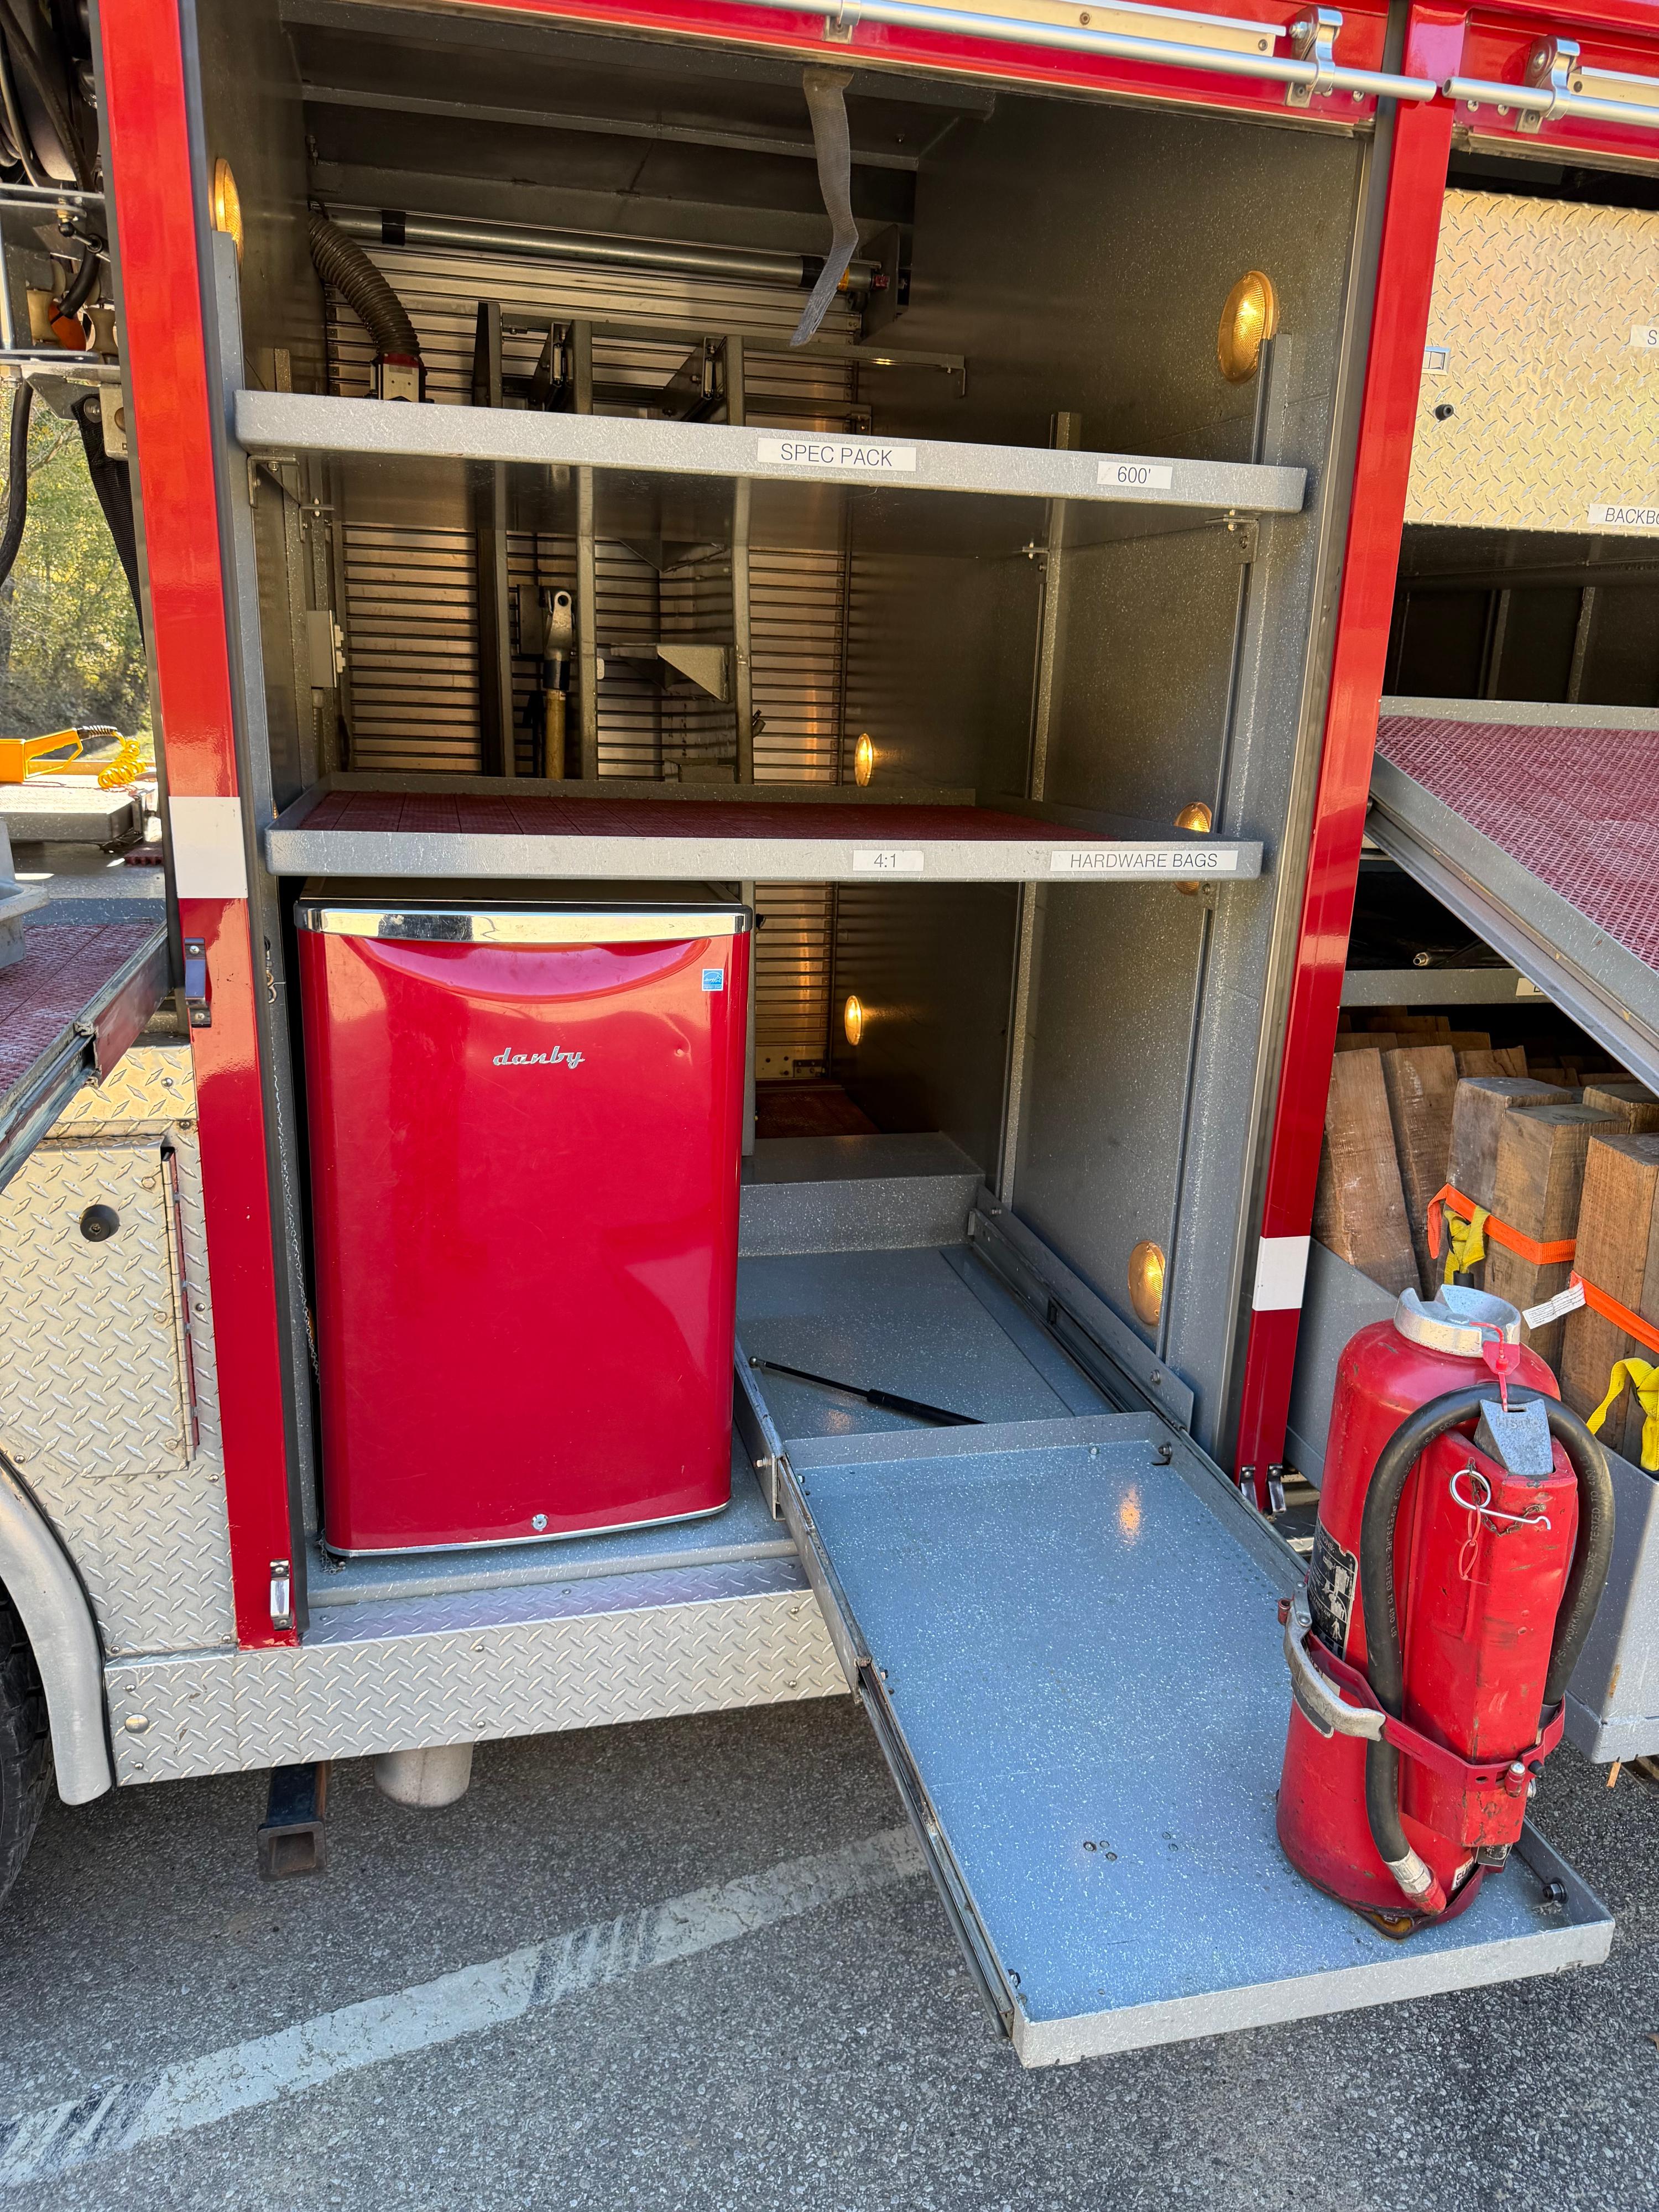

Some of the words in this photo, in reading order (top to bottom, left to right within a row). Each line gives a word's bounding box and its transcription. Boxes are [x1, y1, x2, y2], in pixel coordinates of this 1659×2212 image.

[1647, 330, 1659, 345] S
[781, 443, 834, 463] SPEC
[841, 447, 893, 467] PACK
[1118, 466, 1151, 484] 600'
[873, 853, 896, 868] 4:1
[1070, 853, 1167, 868] HARDWARE
[1172, 853, 1218, 868] BAGS
[493, 1046, 586, 1069] danby
